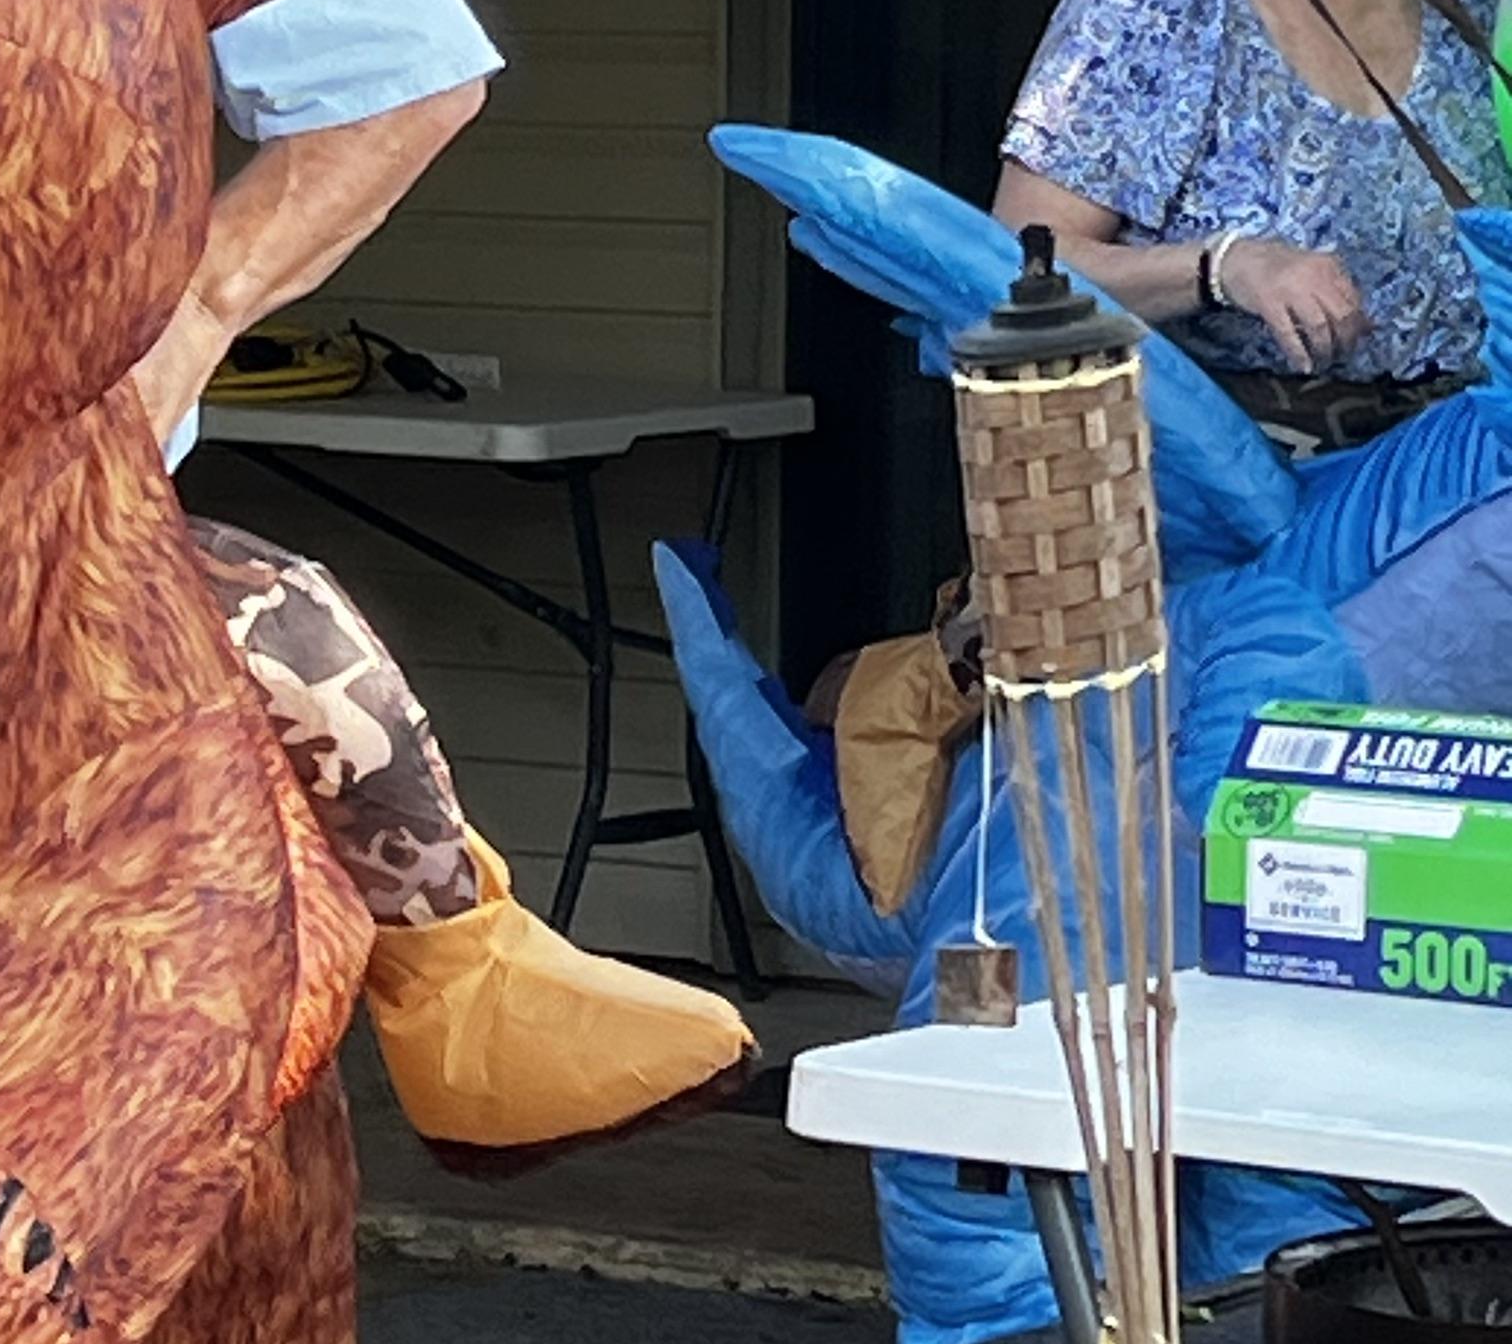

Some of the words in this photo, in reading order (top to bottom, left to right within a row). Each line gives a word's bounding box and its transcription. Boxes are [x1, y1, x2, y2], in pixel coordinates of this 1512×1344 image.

[1346, 732, 1440, 772] DUTY
[1438, 740, 1512, 779] EAVY
[1378, 927, 1512, 998] 500F
